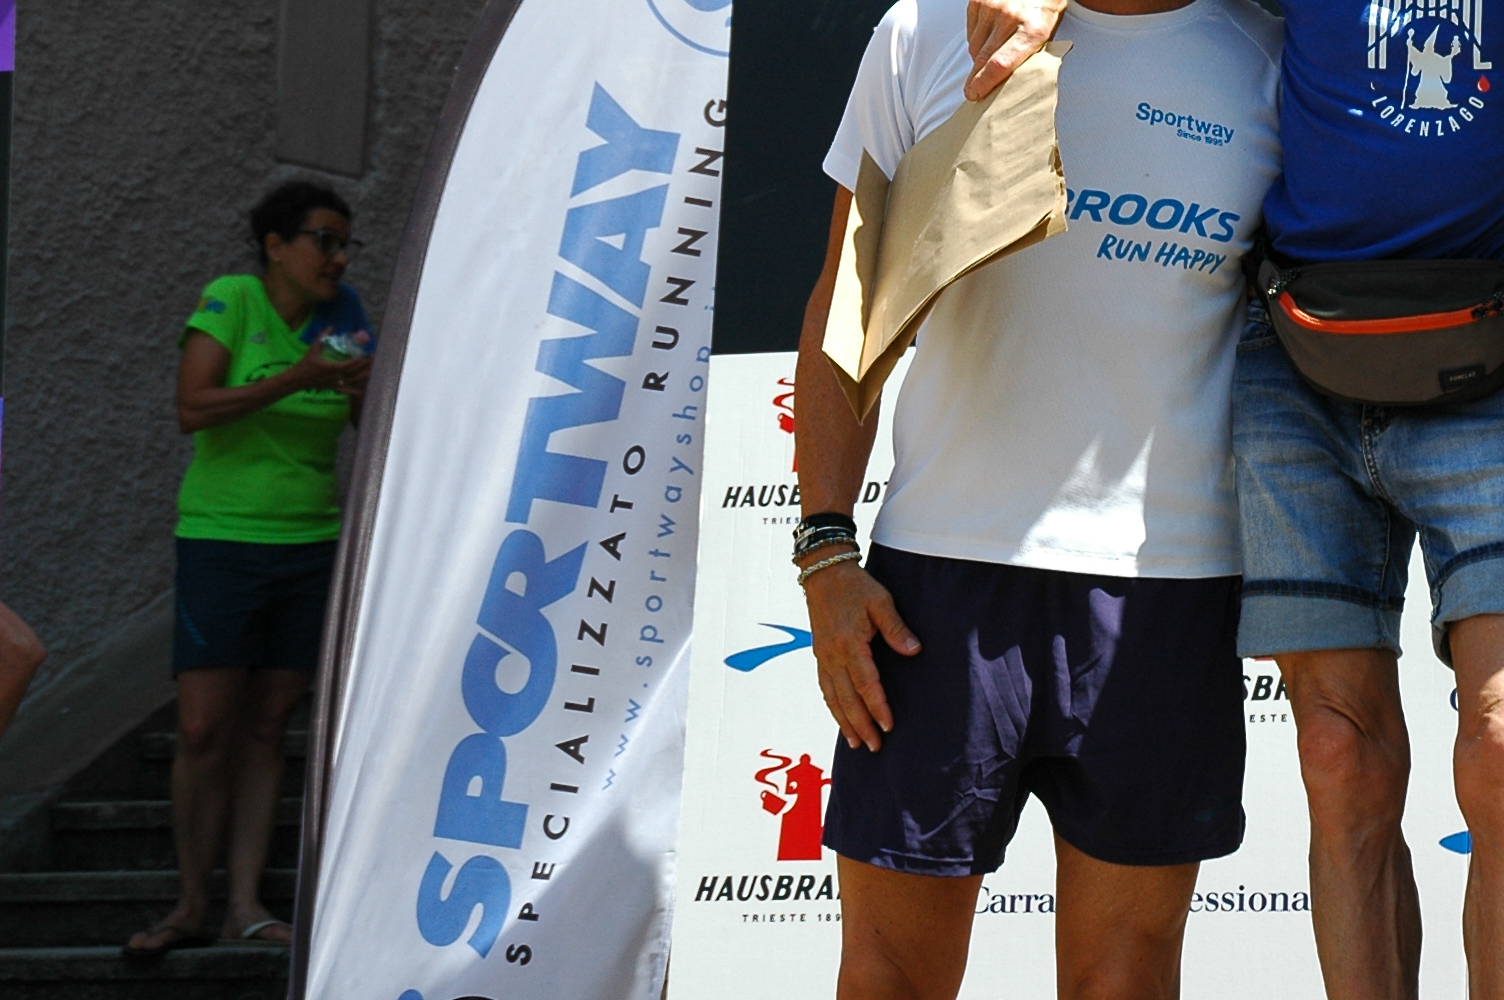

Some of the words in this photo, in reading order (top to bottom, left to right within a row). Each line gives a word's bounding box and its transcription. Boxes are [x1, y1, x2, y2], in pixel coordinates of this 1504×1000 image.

[1136, 102, 1234, 144] Sportway
[1177, 129, 1202, 142] Since
[1372, 95, 1484, 137] LORENZAGO
[1065, 188, 1241, 243] ROOKS
[1096, 233, 1152, 263] RUN
[1154, 241, 1227, 275] HAPPY
[416, 80, 681, 959] SPORTWAY
[506, 445, 646, 966] SPECIALIZZATO
[641, 98, 727, 392] RUNNING
[695, 874, 841, 901] HAUSBRA
[742, 913, 807, 923] TRIESTE
[817, 912, 842, 922] 189
